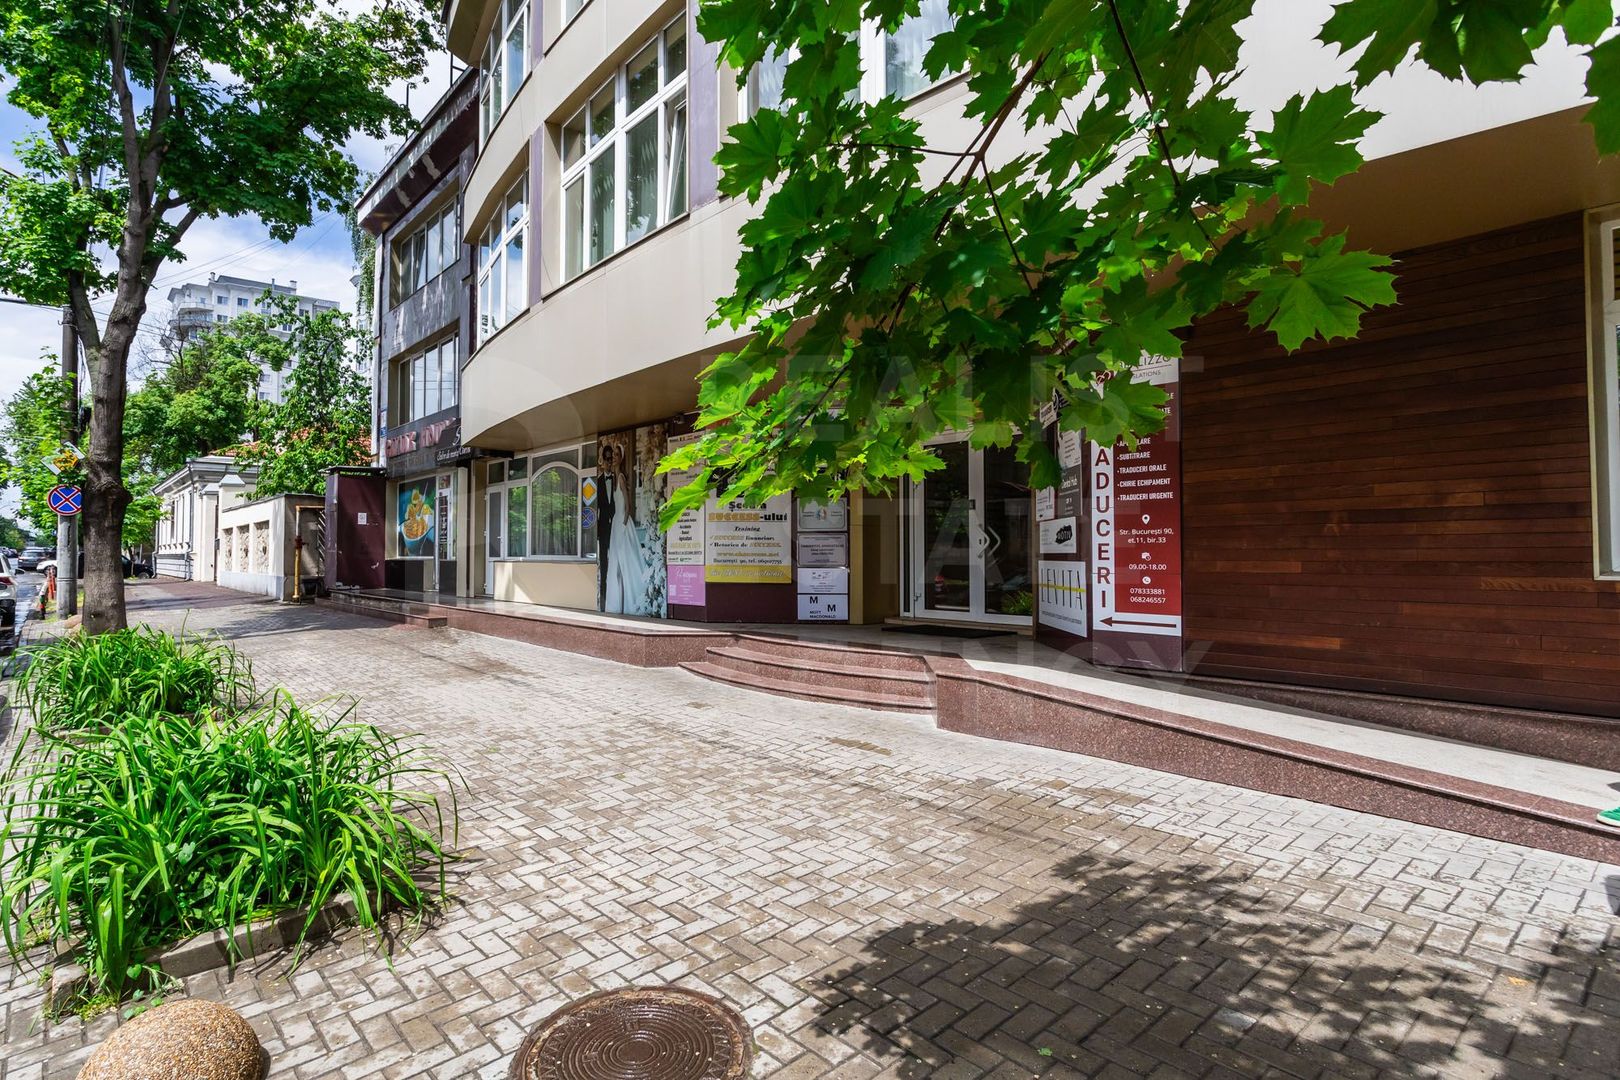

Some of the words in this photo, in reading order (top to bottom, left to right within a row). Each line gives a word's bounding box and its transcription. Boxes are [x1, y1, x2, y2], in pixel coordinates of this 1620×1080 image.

[1119, 451, 1151, 461] SUBTITRARE
[1119, 465, 1148, 474] TRADUCERI
[1148, 464, 1167, 472] ORALE
[1119, 479, 1137, 488] CHIRIE
[1137, 477, 1171, 487] ECHIPAMENT
[1119, 493, 1149, 501] TRADUCERI
[1149, 491, 1174, 500] URGENTE
[1095, 448, 1111, 608] ADUCERI
[1041, 567, 1083, 610] LEVITA
